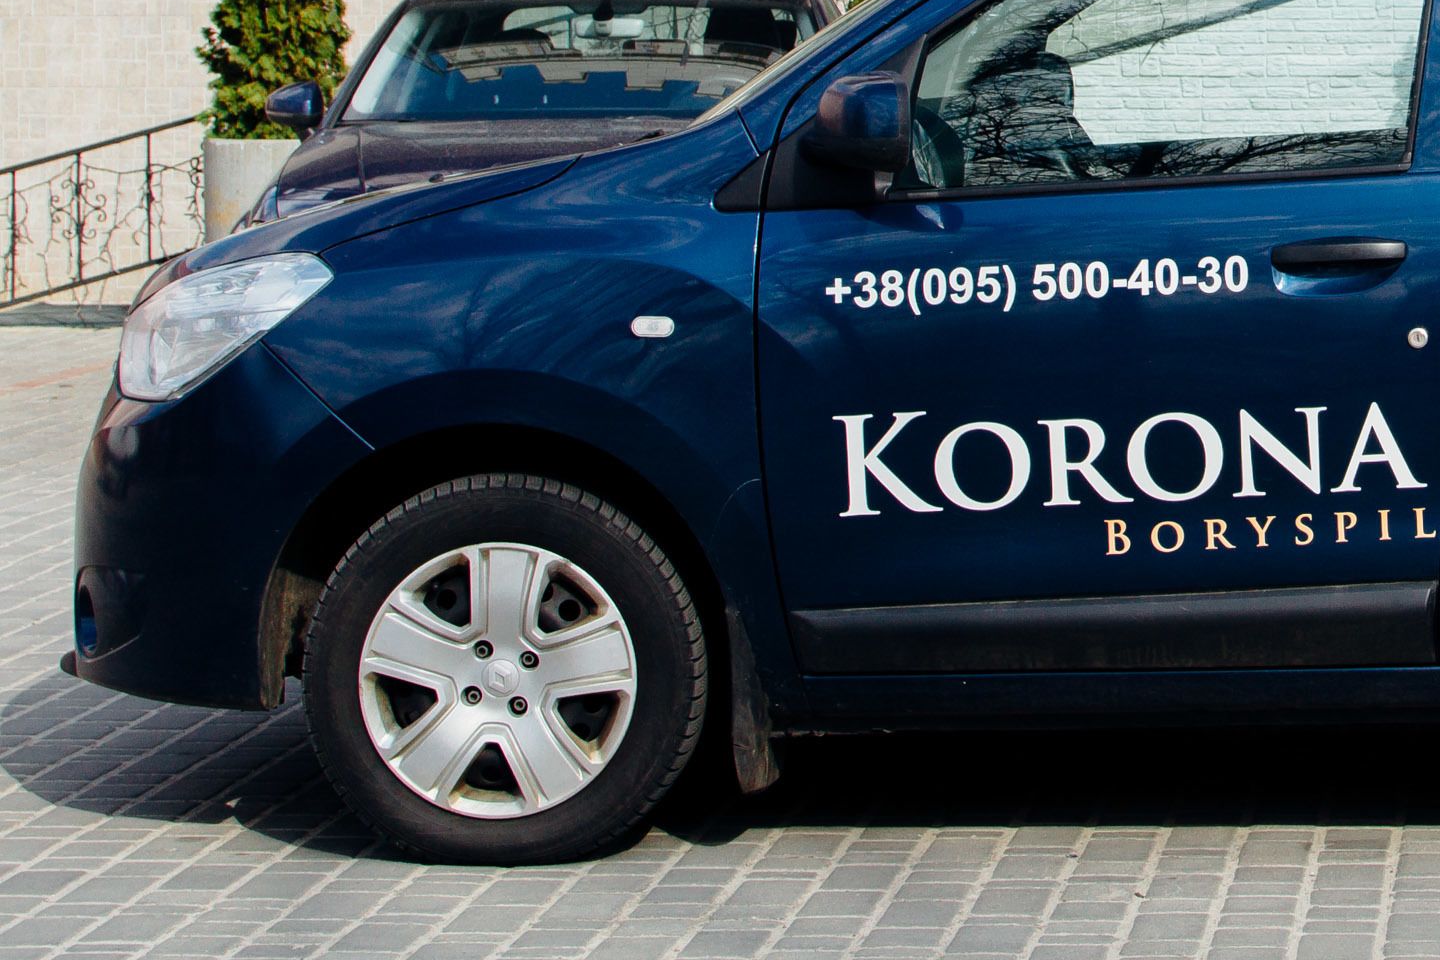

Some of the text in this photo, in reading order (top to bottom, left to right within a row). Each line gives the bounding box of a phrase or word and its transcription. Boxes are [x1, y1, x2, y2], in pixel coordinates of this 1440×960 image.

[825, 255, 1249, 315] +38(095) 500-40-30
[831, 401, 1428, 518] KORONA
[1103, 507, 1437, 556] BORYSPIL
